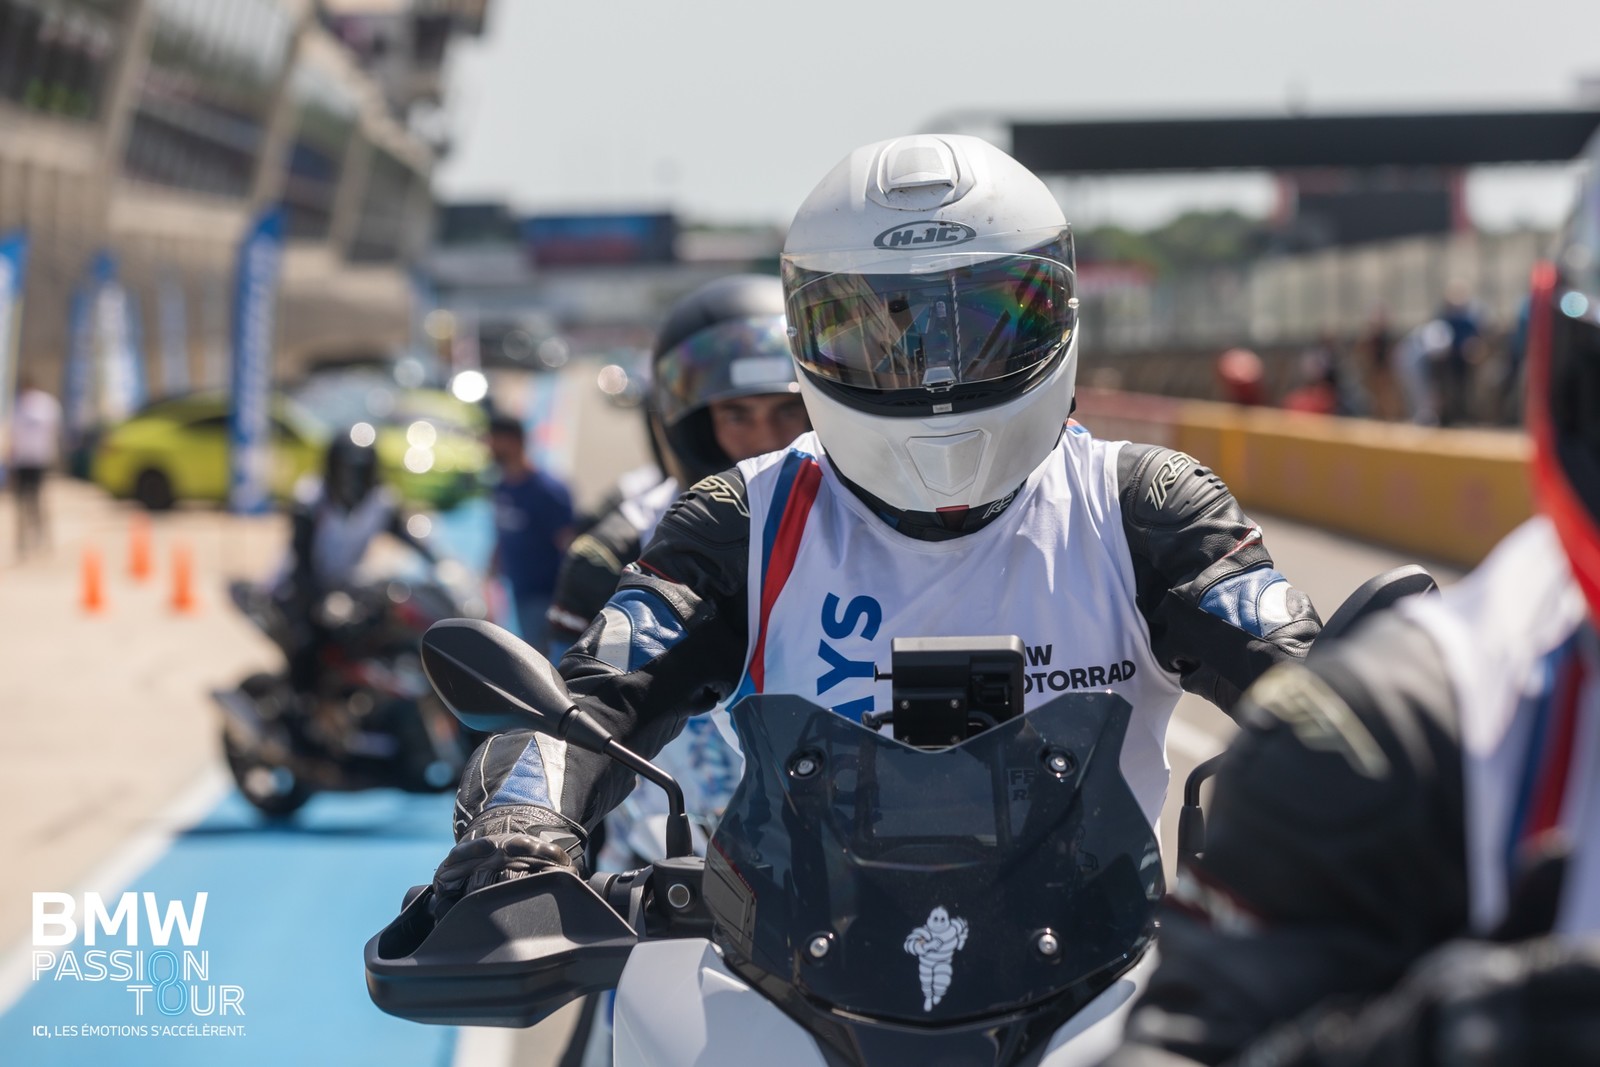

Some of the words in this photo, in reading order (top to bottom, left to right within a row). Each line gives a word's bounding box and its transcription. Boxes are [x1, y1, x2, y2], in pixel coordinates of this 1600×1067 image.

[889, 227, 961, 247] HJC
[689, 475, 750, 517] ST
[1145, 451, 1200, 511] RS
[817, 591, 882, 735] AYS
[1024, 660, 1136, 694] TORRAD
